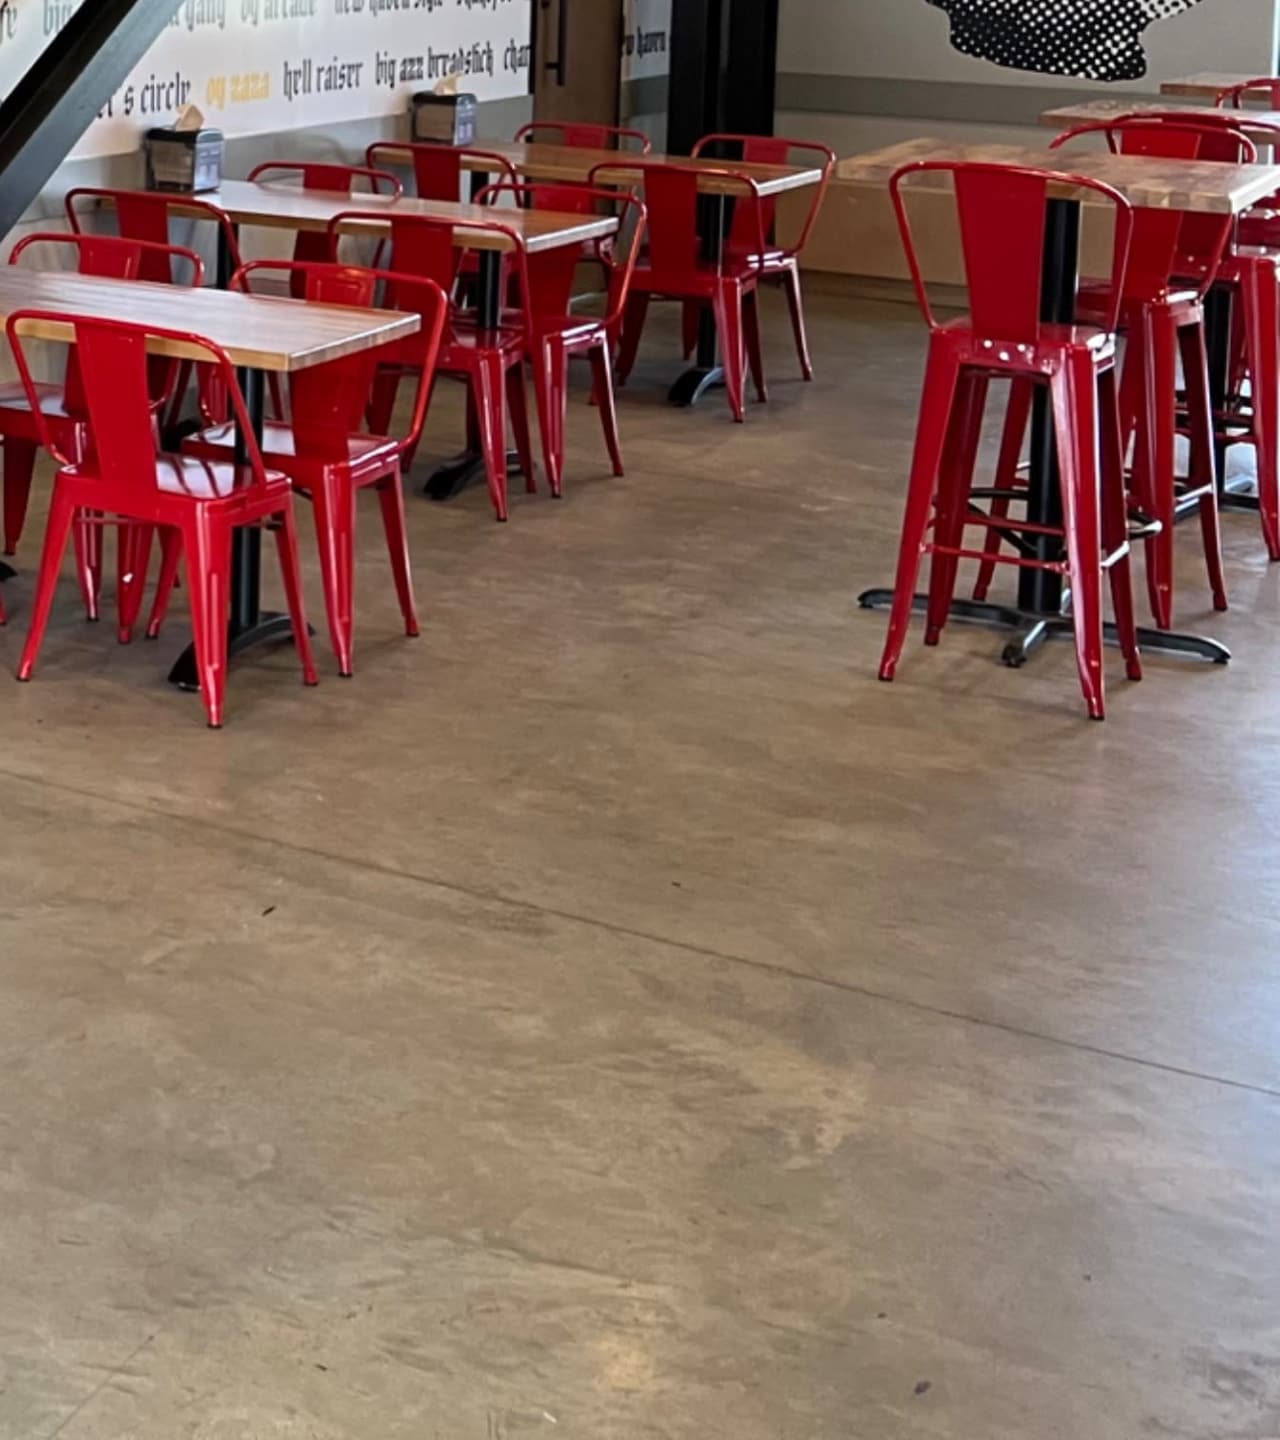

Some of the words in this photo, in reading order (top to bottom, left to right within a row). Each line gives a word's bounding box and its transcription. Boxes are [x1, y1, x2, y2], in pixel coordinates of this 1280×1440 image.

[140, 72, 191, 113] circle
[206, 76, 226, 110] og
[230, 72, 270, 103] zaza
[283, 60, 312, 101] hell
[316, 56, 363, 92] raiser
[375, 51, 396, 88] big
[400, 55, 424, 82] azz
